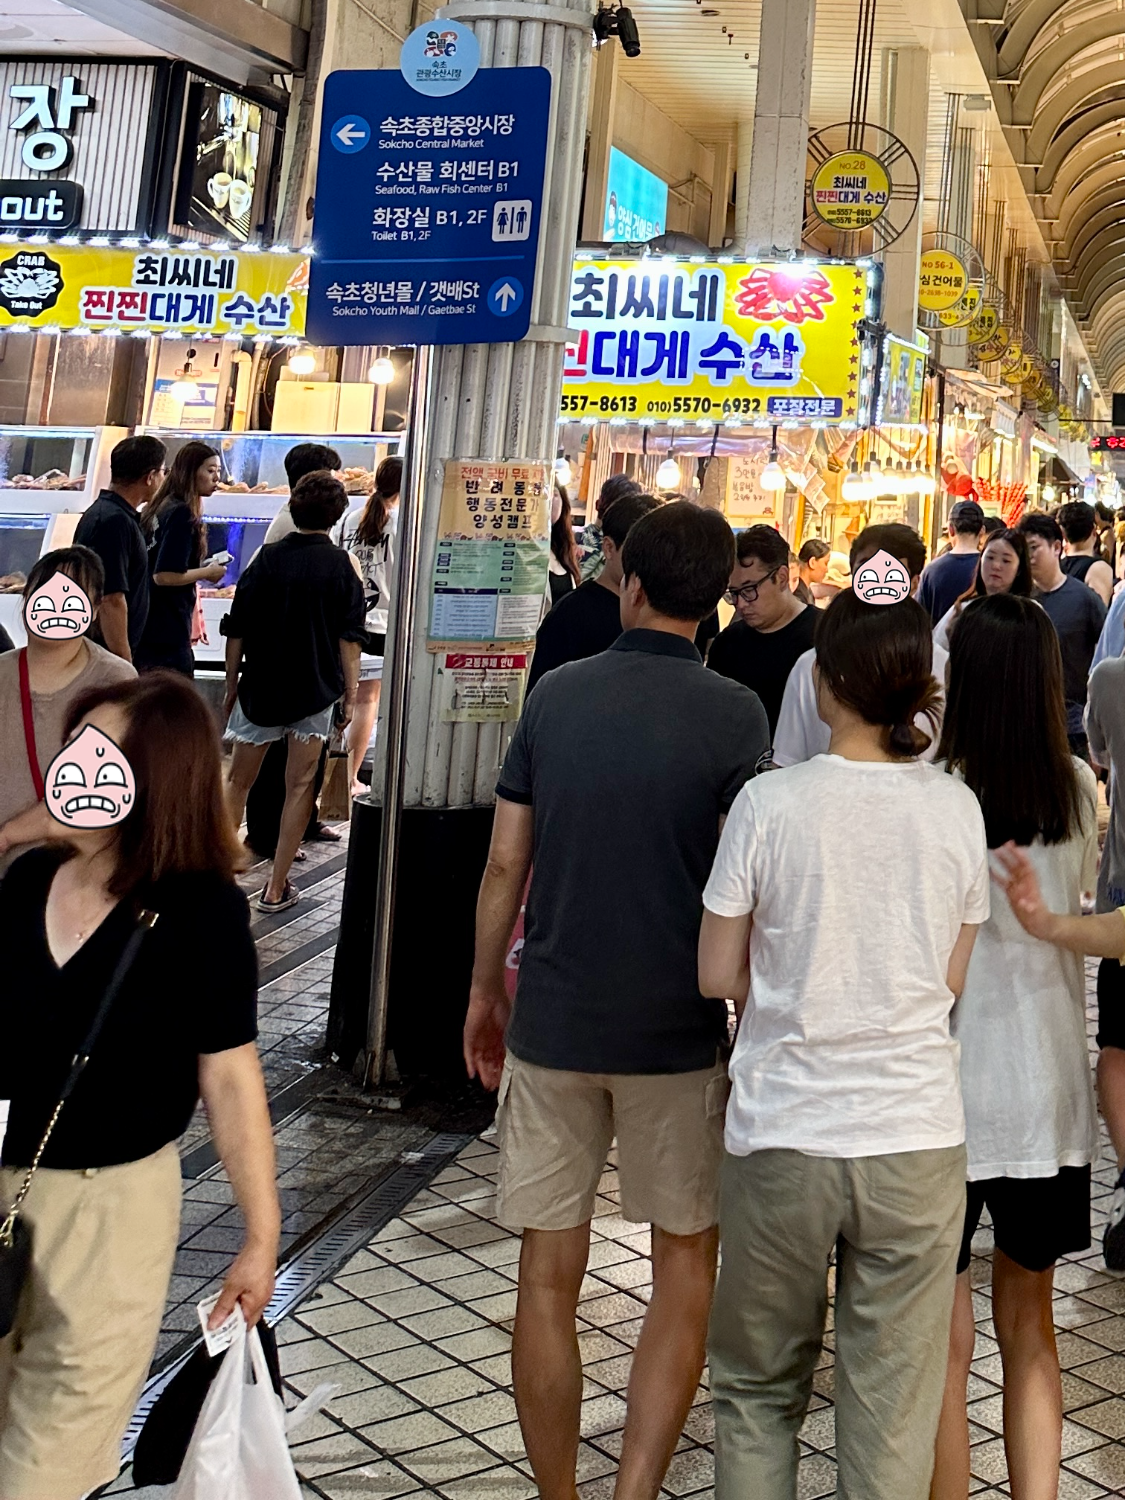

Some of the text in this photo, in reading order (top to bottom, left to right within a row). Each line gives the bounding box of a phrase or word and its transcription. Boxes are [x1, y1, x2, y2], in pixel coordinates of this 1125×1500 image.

[9, 75, 91, 172] 장
[379, 114, 515, 138] 속초종합중앙시장
[378, 138, 485, 149] Sokcho Central Market
[376, 159, 519, 182] 수산물 회센터 B1
[832, 175, 867, 189] 최씨네
[375, 183, 508, 196] Seafood, Raw Fish Center B1
[815, 190, 886, 204] 찐찐대게 수산
[372, 206, 430, 229] 화장실
[466, 209, 488, 225] 2F
[371, 230, 398, 241] Toilet
[17, 255, 45, 267] CRAB
[135, 255, 236, 290] 최씨네
[326, 281, 414, 303] 속초청년몰
[430, 280, 480, 302] 갯배St
[919, 274, 963, 288] 심건어물
[82, 289, 291, 327] 찐찐대게 수산
[571, 271, 719, 322] 최씨네
[332, 306, 369, 317] Sokcho
[370, 306, 398, 316] Youth
[400, 305, 419, 315] Mall
[428, 304, 465, 315] Gaetbae
[466, 304, 476, 314] St
[698, 330, 799, 381] 수산
